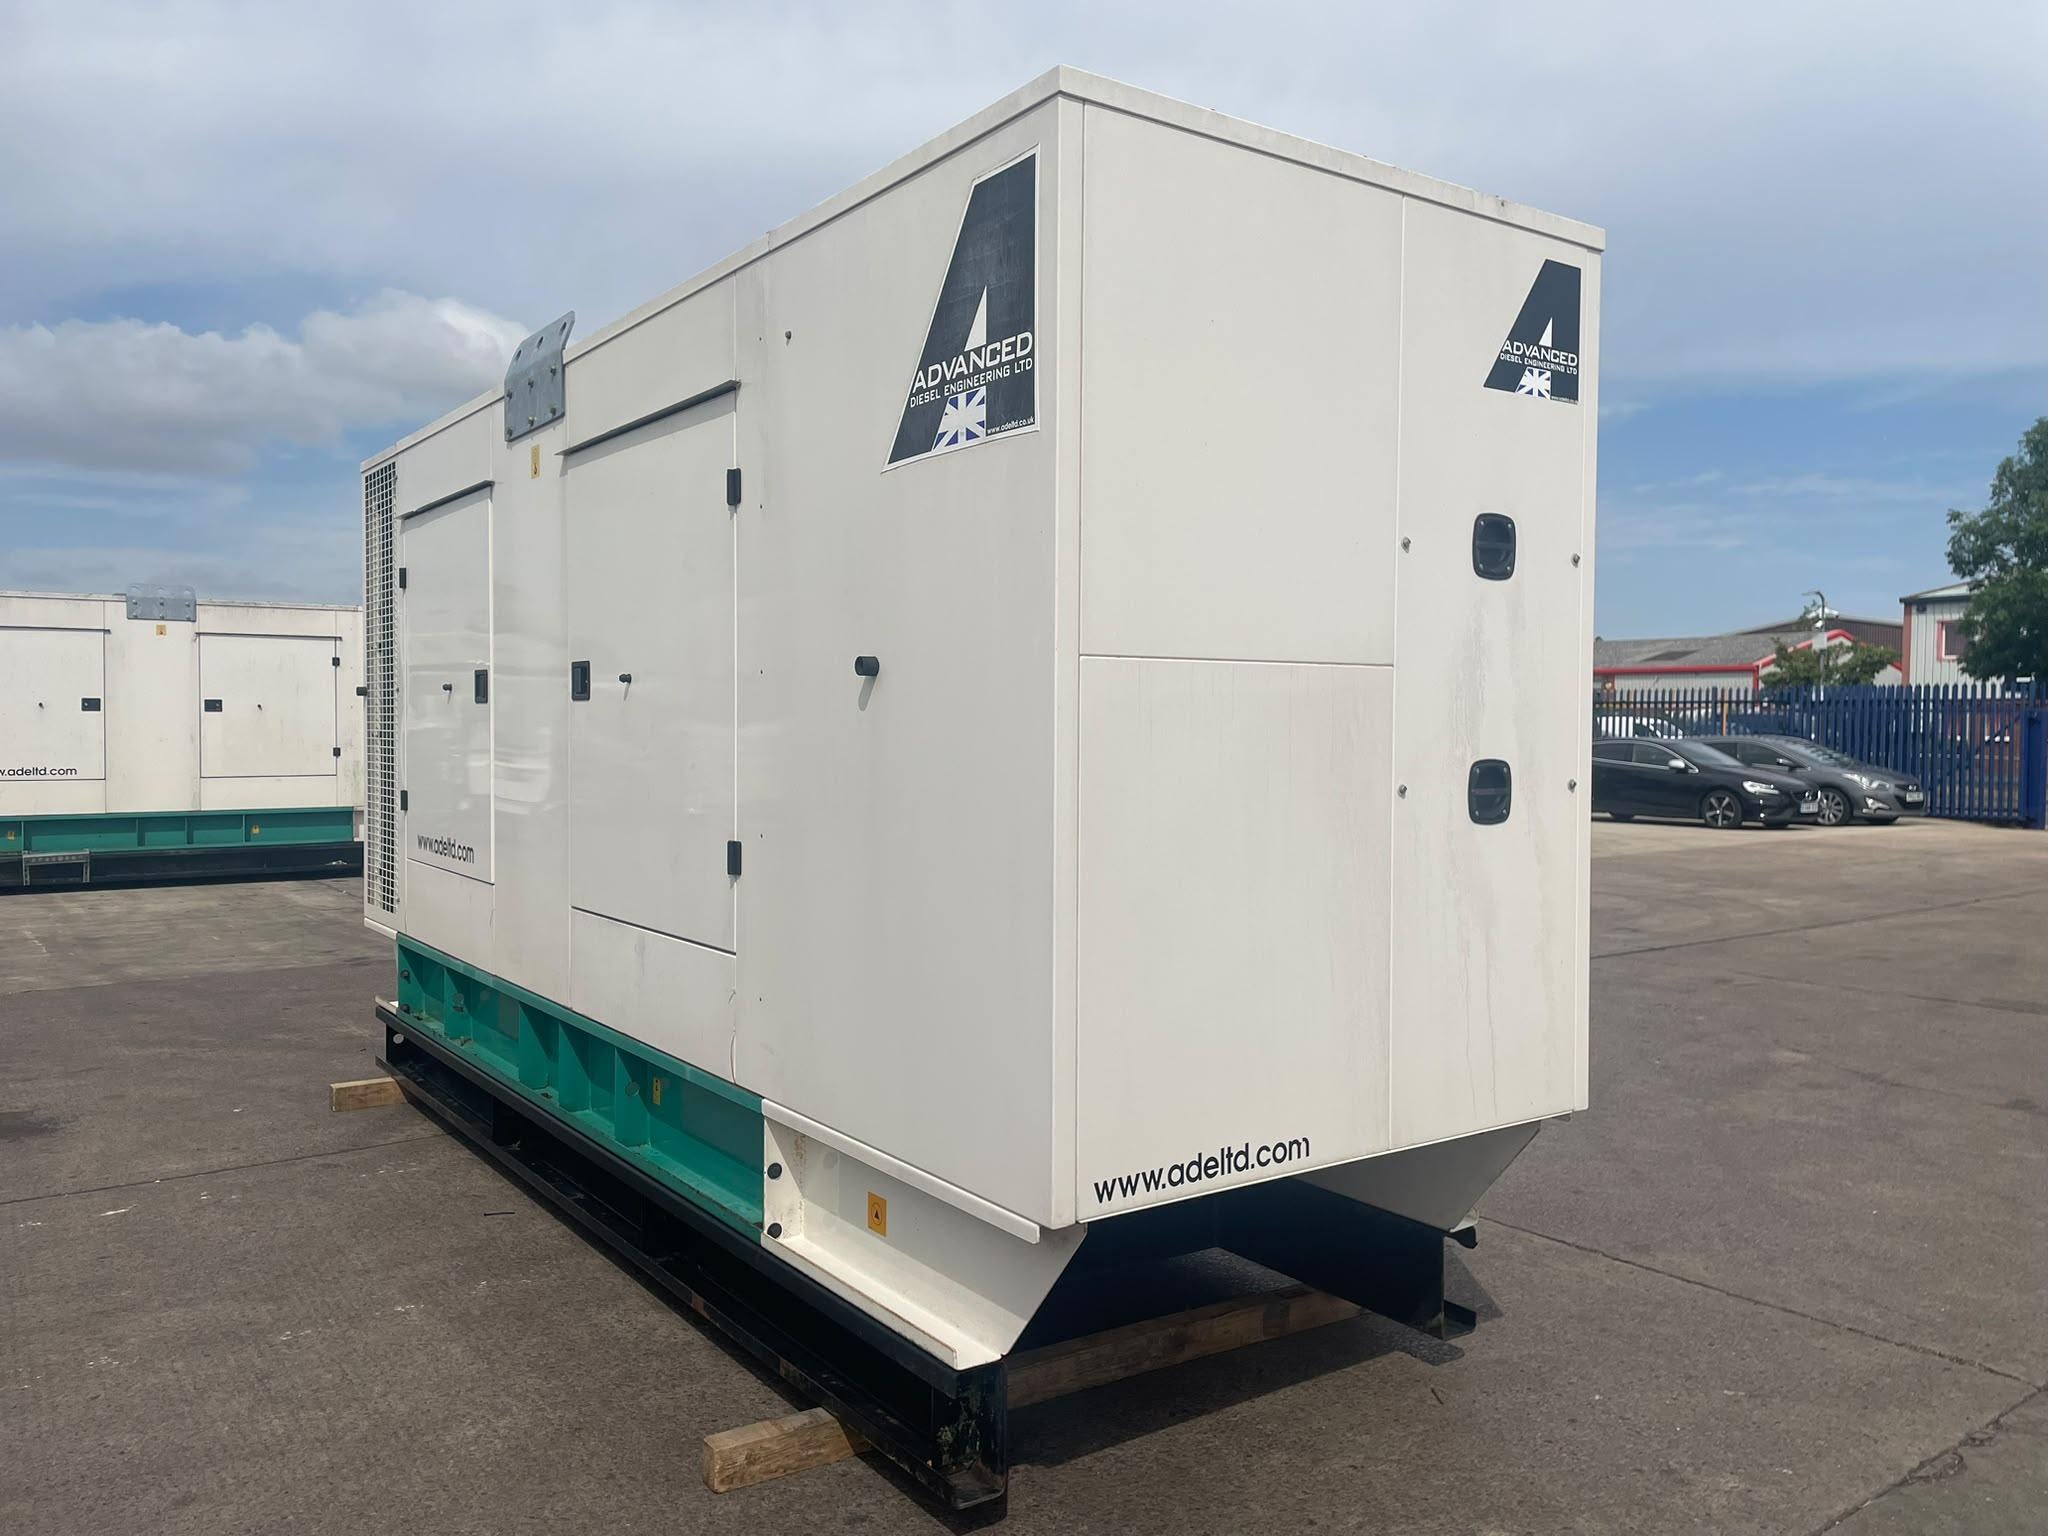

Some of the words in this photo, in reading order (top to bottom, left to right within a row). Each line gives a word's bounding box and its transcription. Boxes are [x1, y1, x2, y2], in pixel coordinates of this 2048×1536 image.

[912, 331, 1033, 393] ADVANCED
[1500, 352, 1522, 364] DIESEL
[1524, 357, 1565, 373] ENGINEERING
[1566, 366, 1578, 375] LTD
[1502, 340, 1578, 366] ADVANCED
[910, 389, 941, 408] DIESEL
[944, 365, 1011, 397] ENGINEERING
[1014, 357, 1033, 374] LTD
[987, 416, 1035, 434] www.adeltd.co.uk
[417, 834, 475, 864] www.adeltd.com
[1093, 1136, 1310, 1204] www.adeltd.com
